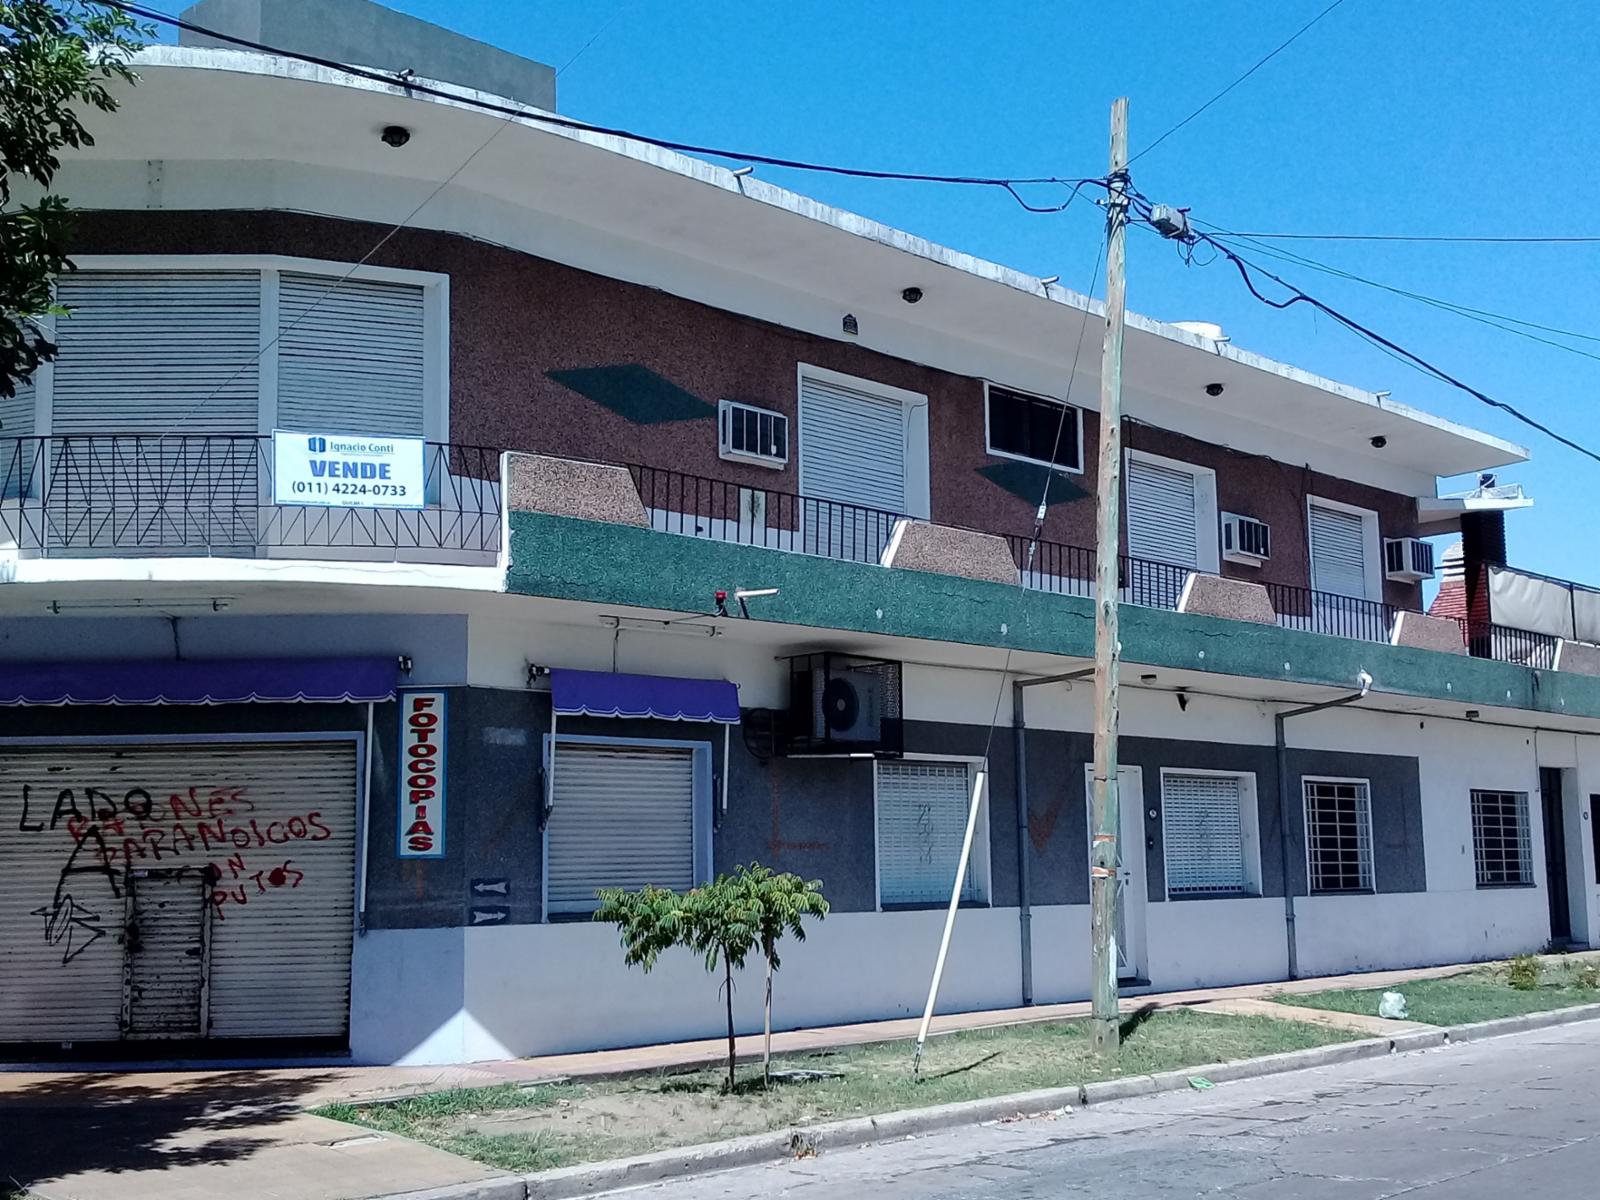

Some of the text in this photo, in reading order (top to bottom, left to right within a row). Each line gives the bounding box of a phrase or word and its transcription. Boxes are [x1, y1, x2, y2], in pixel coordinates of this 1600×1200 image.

[330, 441, 394, 454] Ignacio Conti
[309, 459, 392, 480] VENDE
[292, 480, 407, 497] (011) 4224-0733
[405, 697, 438, 852] FOTOCOPIAS
[19, 784, 152, 832] LADO
